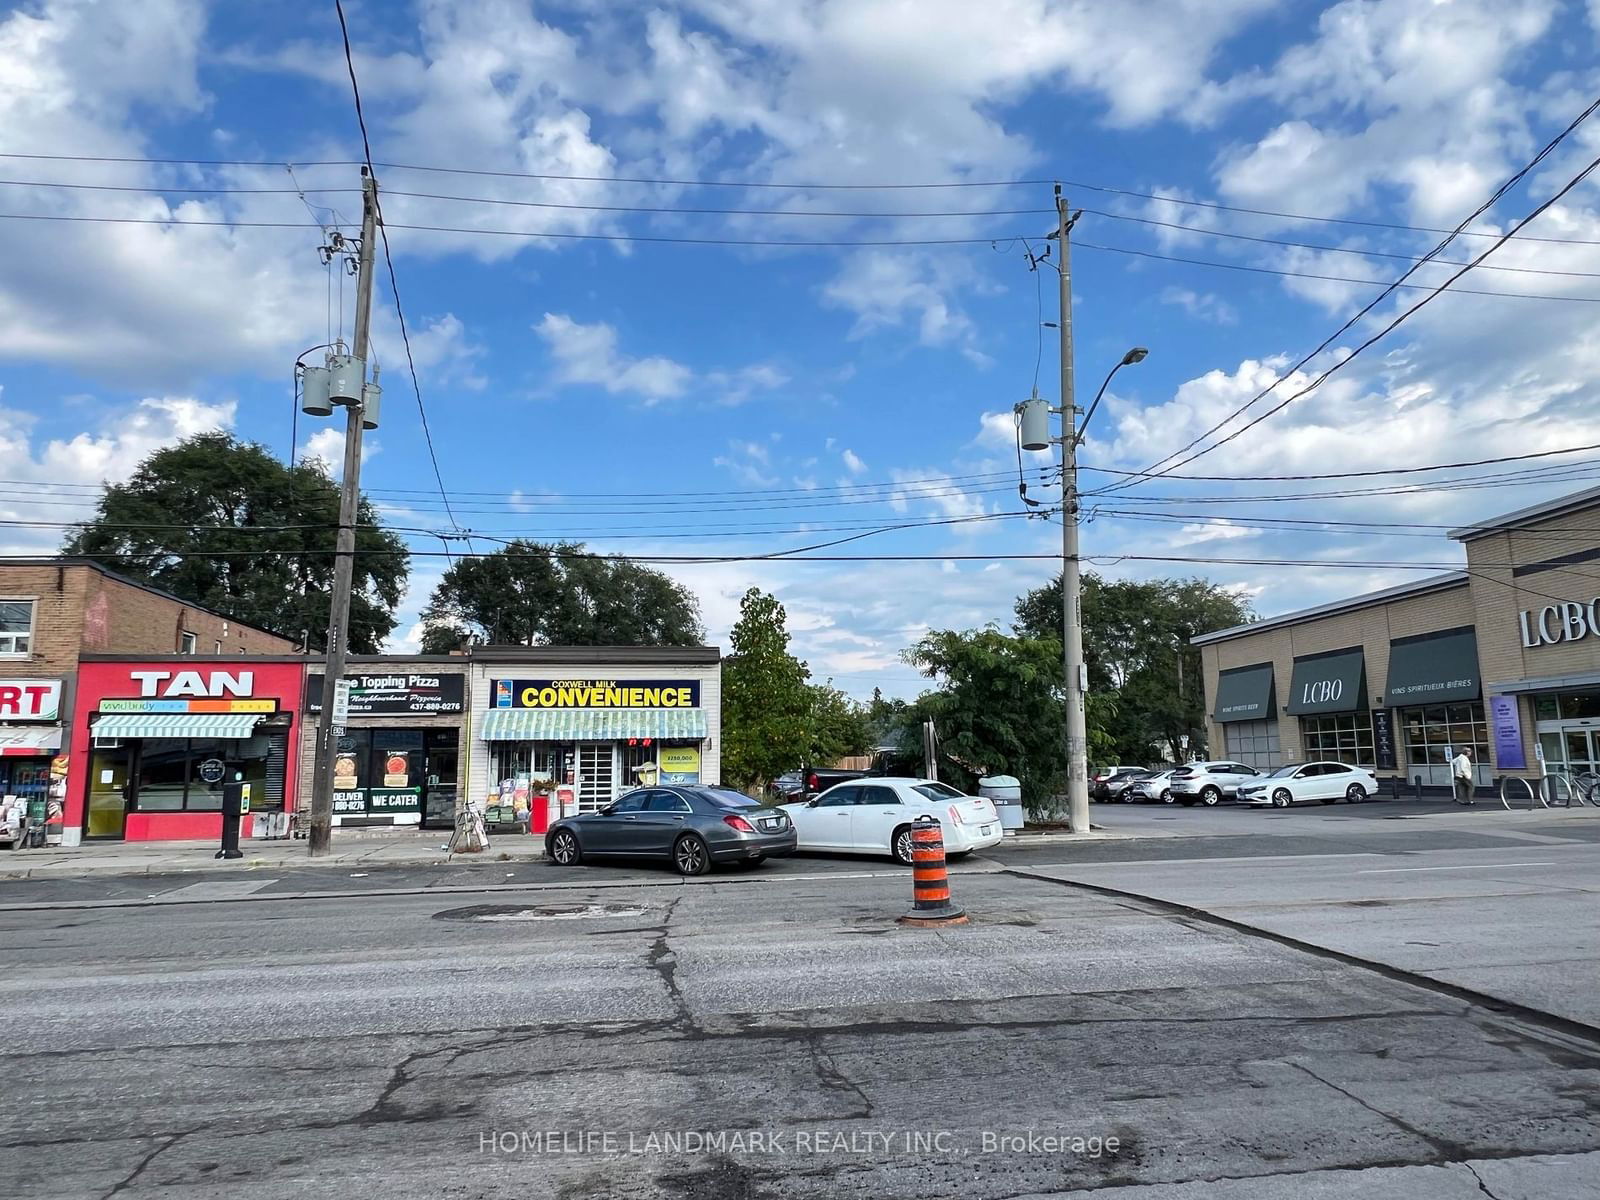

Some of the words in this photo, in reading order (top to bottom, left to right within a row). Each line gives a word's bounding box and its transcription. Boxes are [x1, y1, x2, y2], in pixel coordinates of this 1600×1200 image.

[130, 671, 254, 697] TAN
[360, 675, 406, 689] Topping
[408, 675, 440, 688] Pizza
[551, 680, 592, 689] COXWELL
[595, 680, 617, 689] MILK
[521, 687, 692, 707] CONVENIENCE
[1302, 679, 1342, 704] LCBO
[372, 795, 388, 807] WE
[388, 794, 418, 807] CATER
